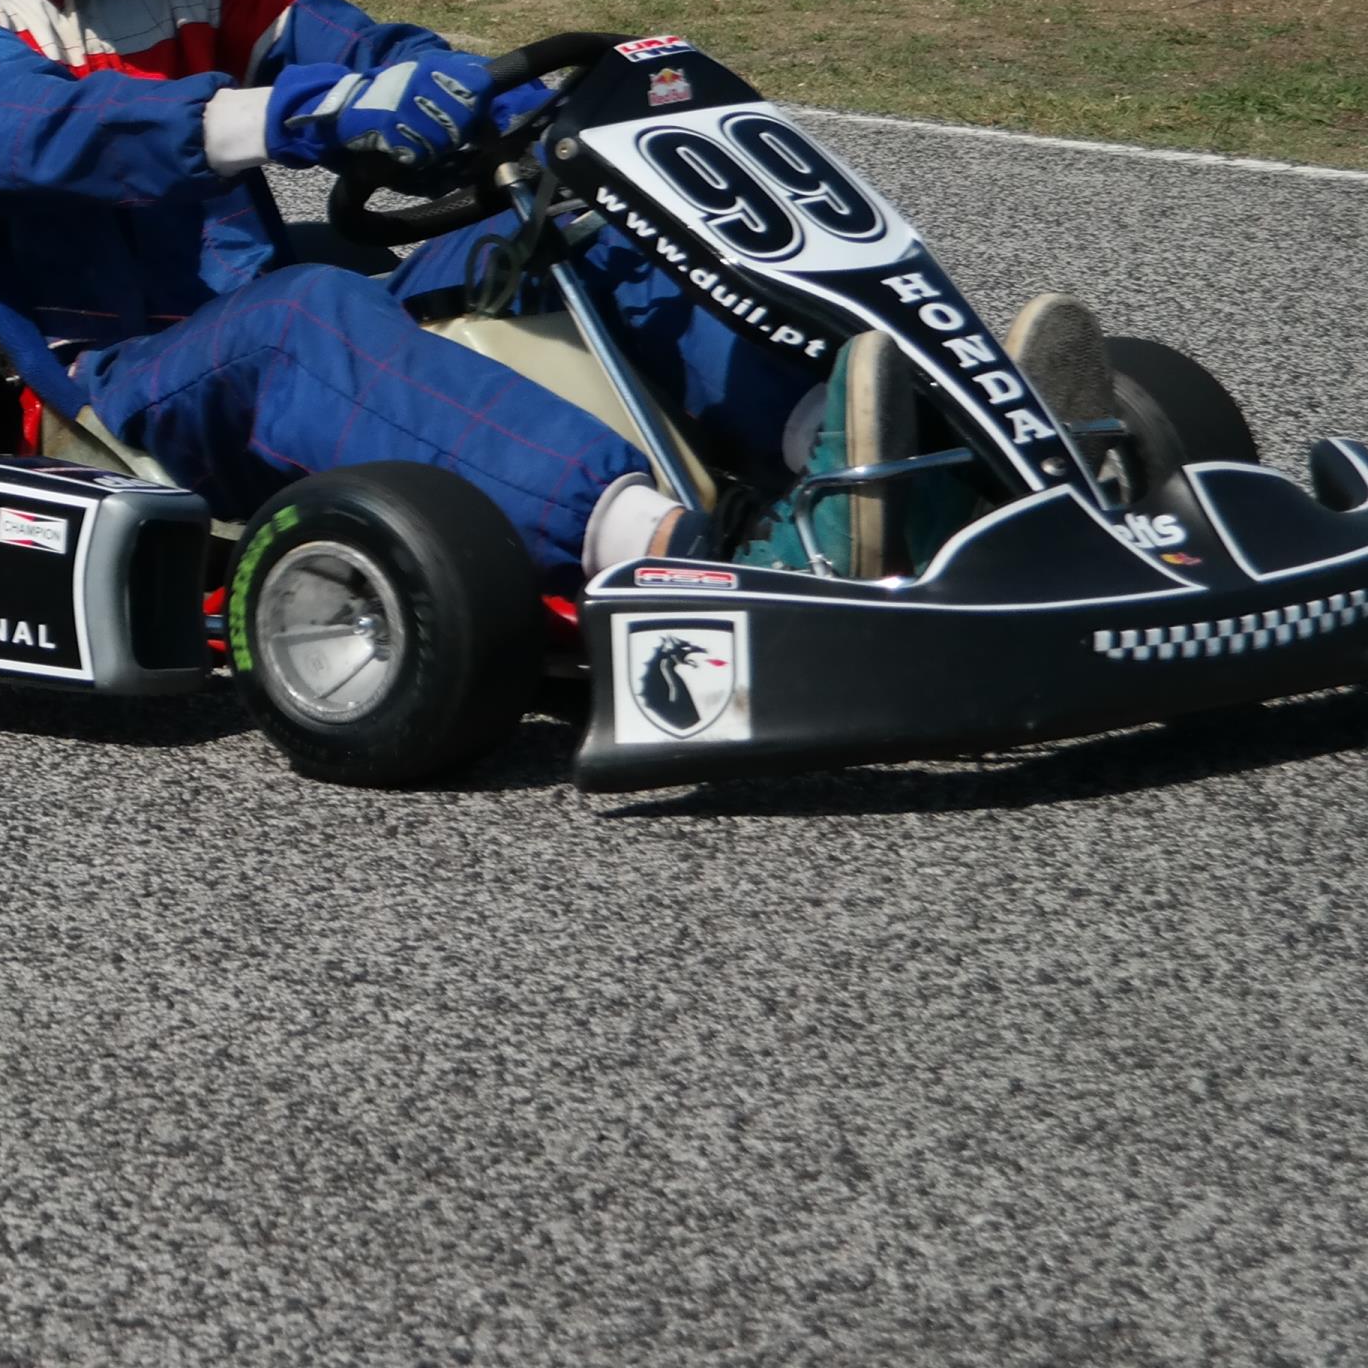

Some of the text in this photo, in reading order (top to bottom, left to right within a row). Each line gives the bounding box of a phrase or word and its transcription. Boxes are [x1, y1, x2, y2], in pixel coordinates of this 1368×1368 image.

[633, 111, 888, 264] 99
[595, 185, 829, 360] www.duil.pt
[879, 272, 1057, 445] HONDA
[3, 519, 62, 541] CHAMPION
